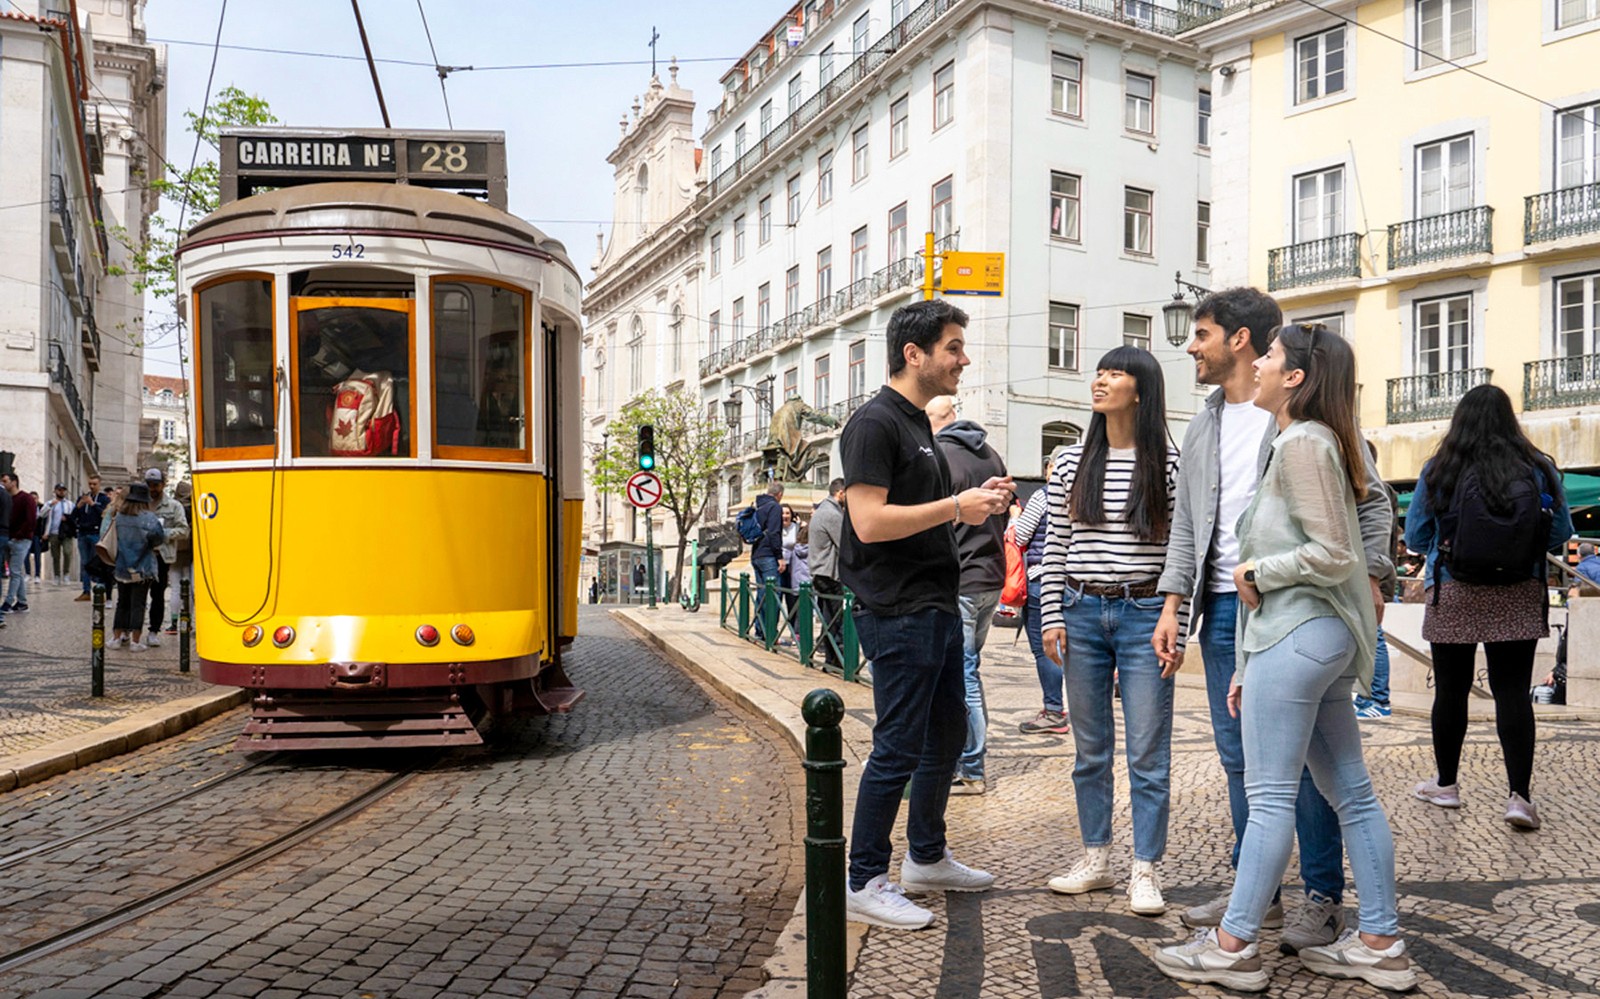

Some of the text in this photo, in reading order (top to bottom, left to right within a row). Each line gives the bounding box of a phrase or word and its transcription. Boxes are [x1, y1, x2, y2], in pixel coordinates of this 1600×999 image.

[239, 141, 351, 166] CARREIRA
[421, 142, 468, 172] 28
[332, 244, 365, 259] 542
